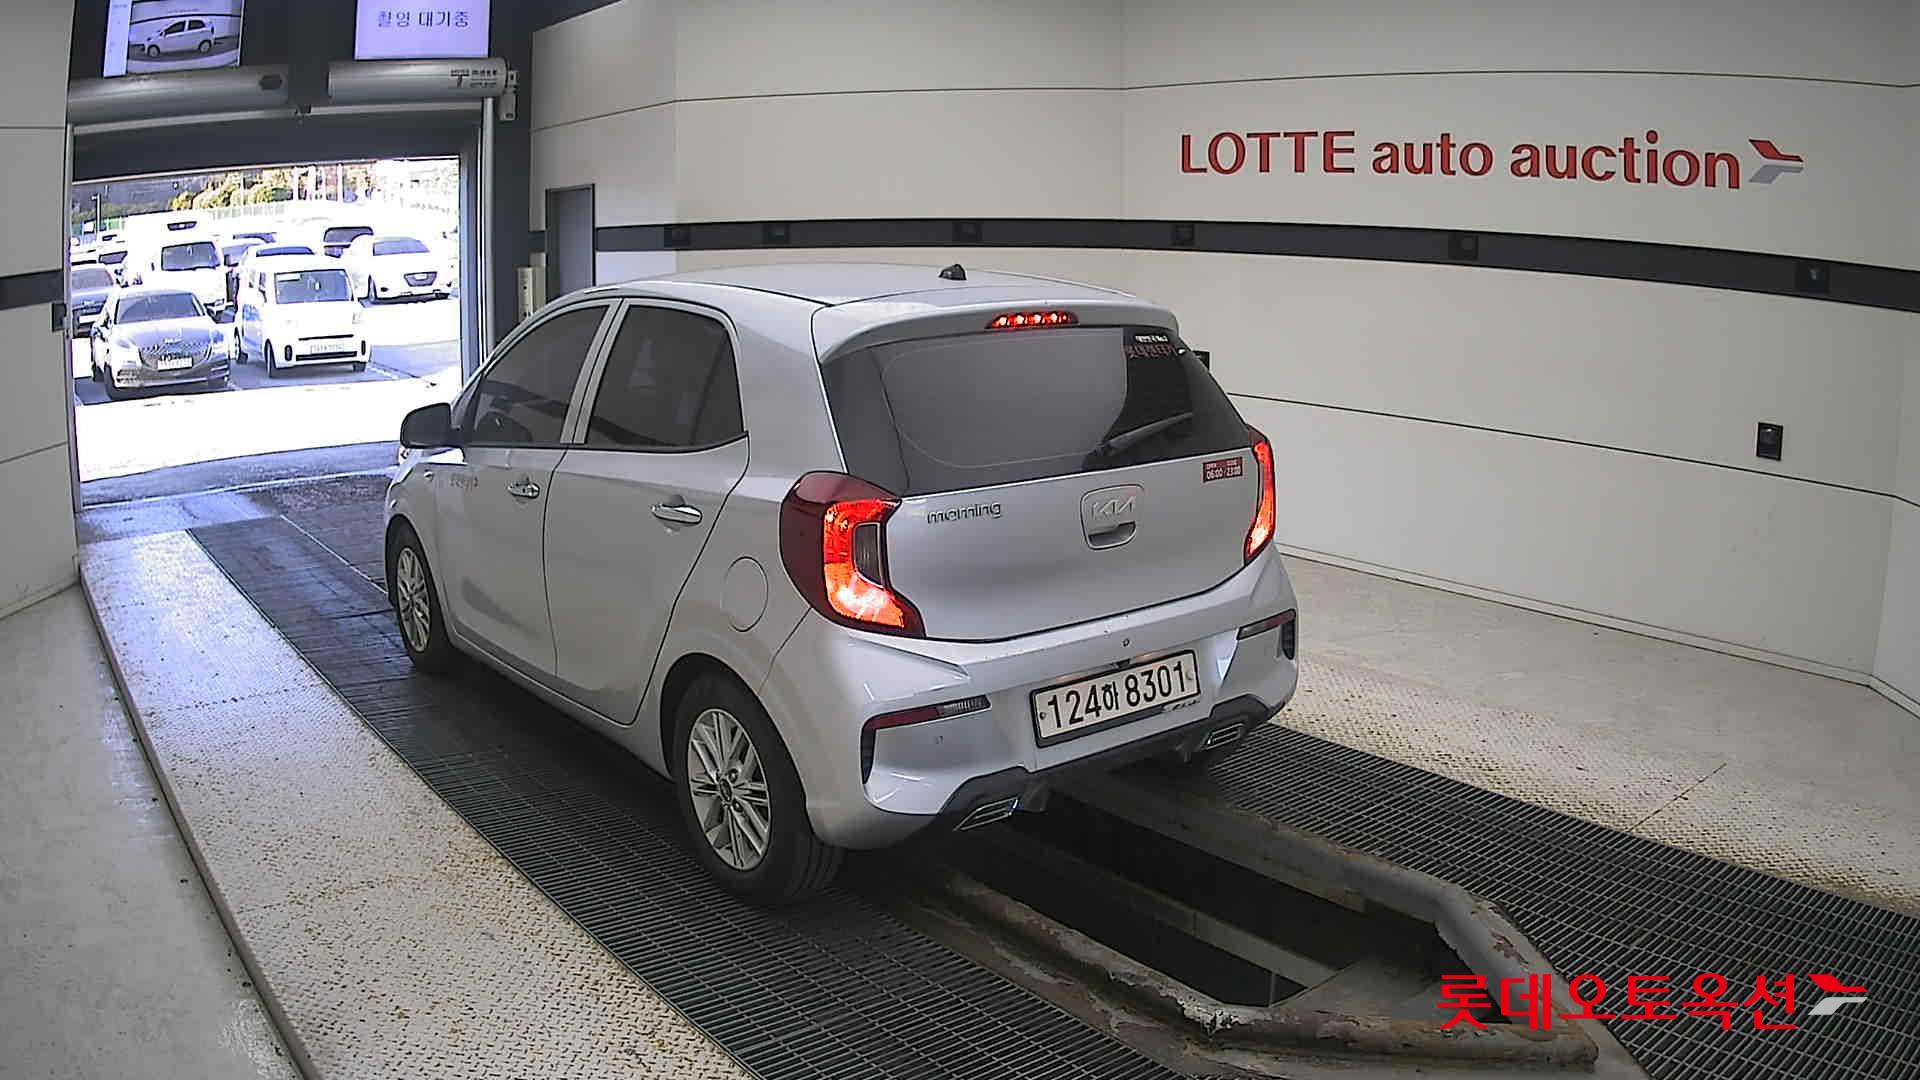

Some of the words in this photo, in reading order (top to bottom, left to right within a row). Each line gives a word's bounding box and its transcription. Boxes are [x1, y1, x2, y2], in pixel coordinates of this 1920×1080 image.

[1181, 131, 1355, 174] LOTTE
[1373, 133, 1494, 177] auto
[1510, 130, 1741, 190] auction
[1091, 496, 1137, 519] KIA
[1123, 660, 1186, 708] 8301
